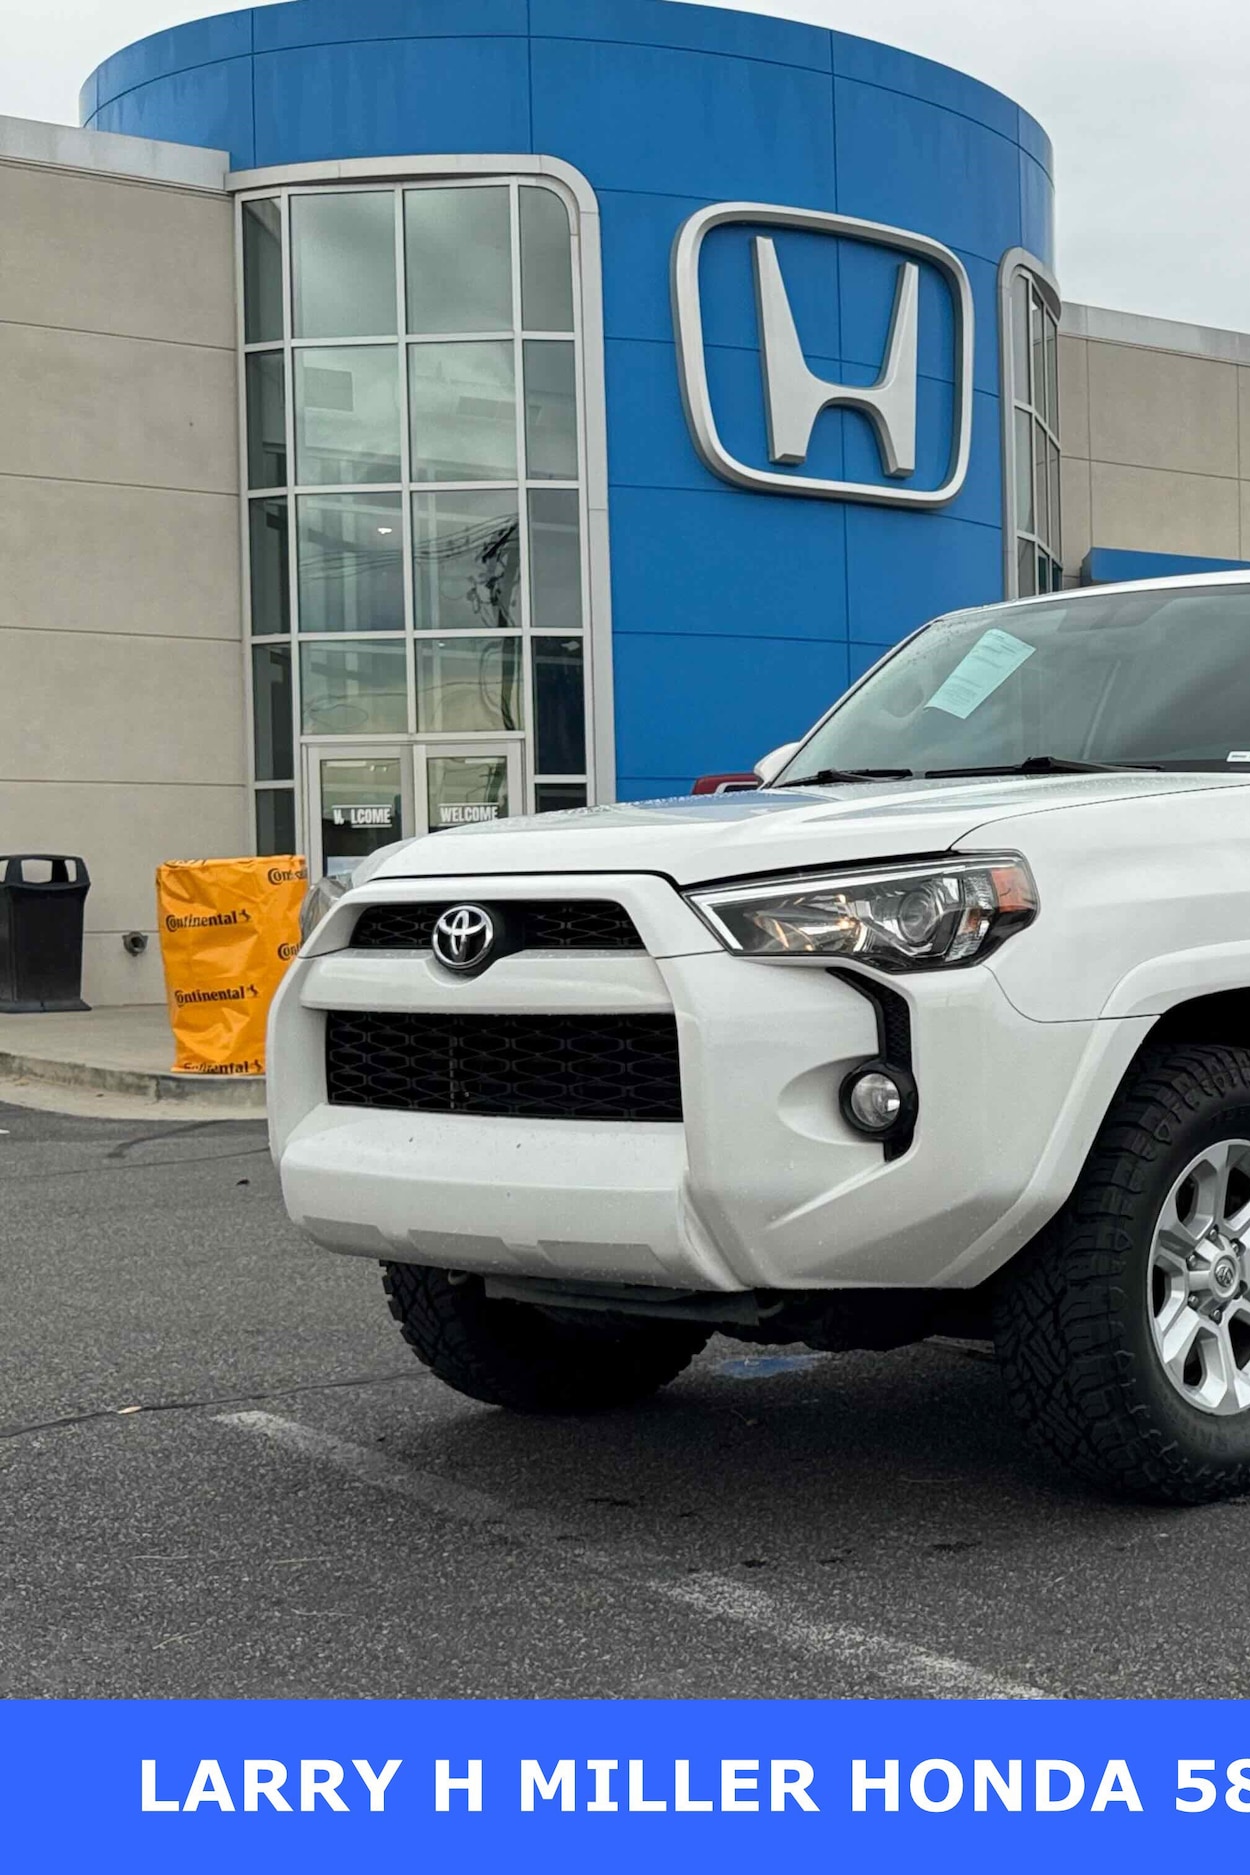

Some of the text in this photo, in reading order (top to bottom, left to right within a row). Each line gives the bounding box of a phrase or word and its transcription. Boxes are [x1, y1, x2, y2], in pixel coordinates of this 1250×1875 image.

[333, 808, 391, 825] WLCOME
[440, 806, 498, 823] WELCOME
[166, 910, 237, 933] Continental
[174, 986, 245, 1008] Continental
